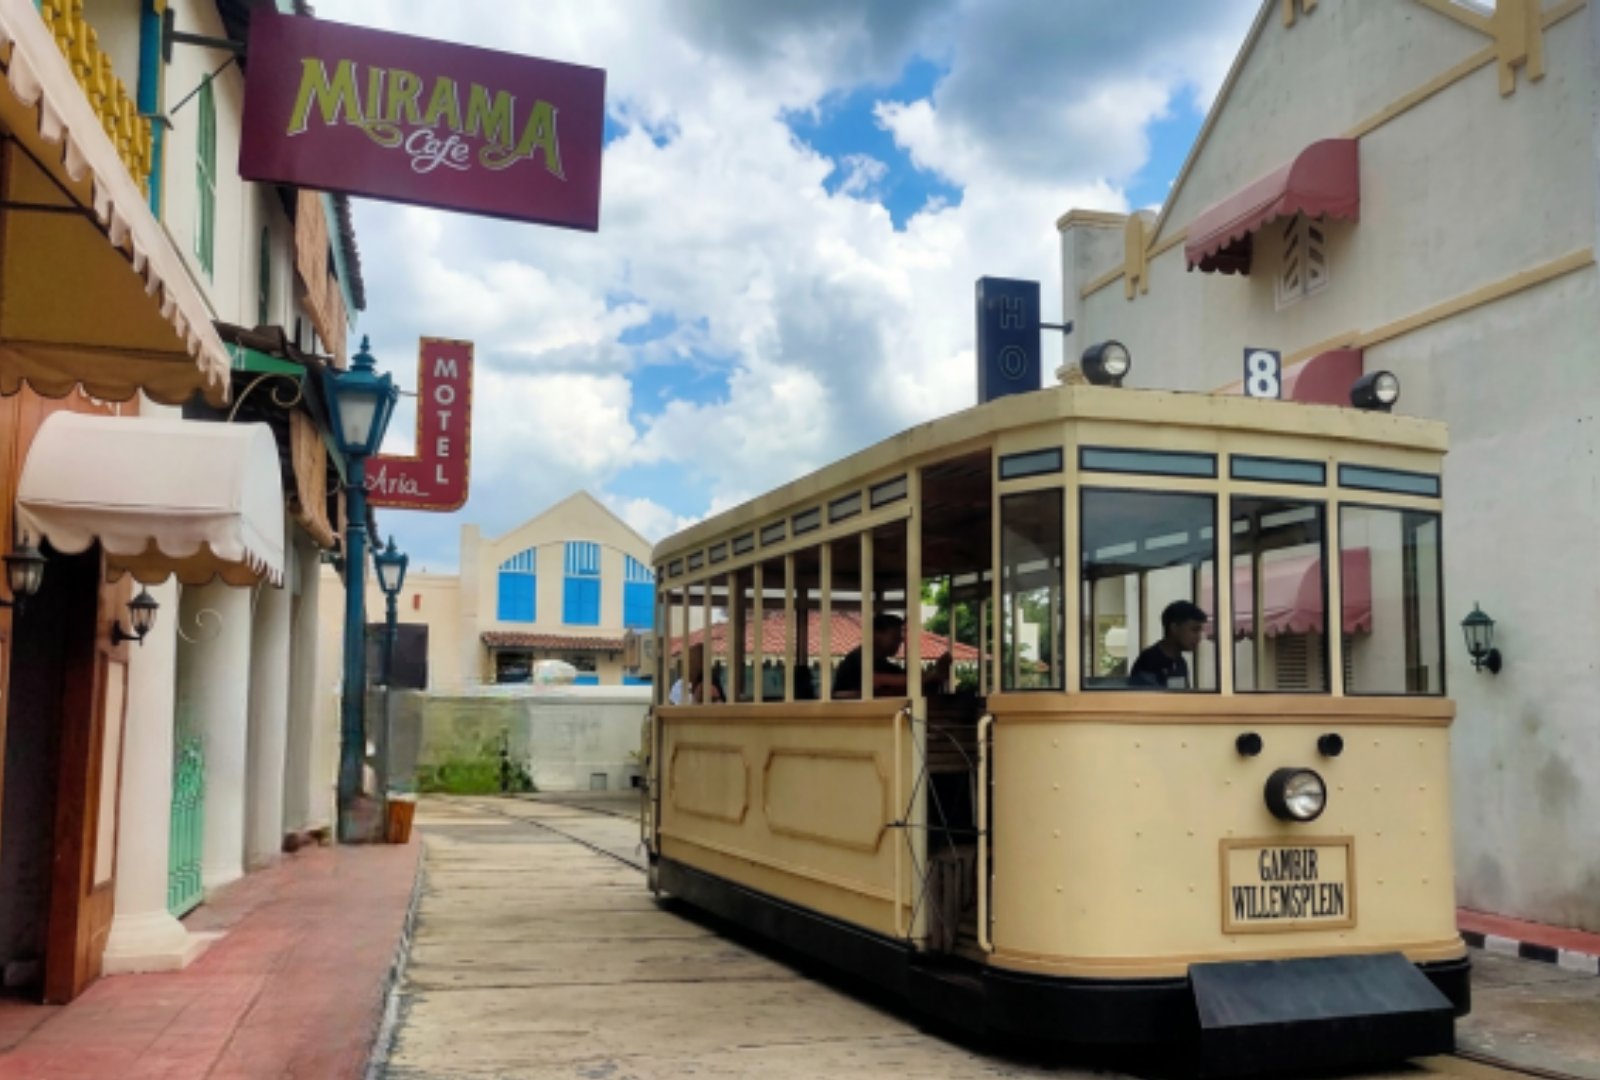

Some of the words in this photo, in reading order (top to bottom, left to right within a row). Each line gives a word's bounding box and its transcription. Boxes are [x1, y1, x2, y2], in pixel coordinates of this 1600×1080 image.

[287, 57, 567, 181] MIRAMA
[405, 129, 471, 173] Cafe
[1248, 350, 1279, 398] 8
[433, 358, 459, 485] MOTEL
[363, 464, 431, 496] Aria
[1258, 848, 1319, 882] GAMBIR
[1231, 883, 1345, 920] WILLEMSPLEIN
